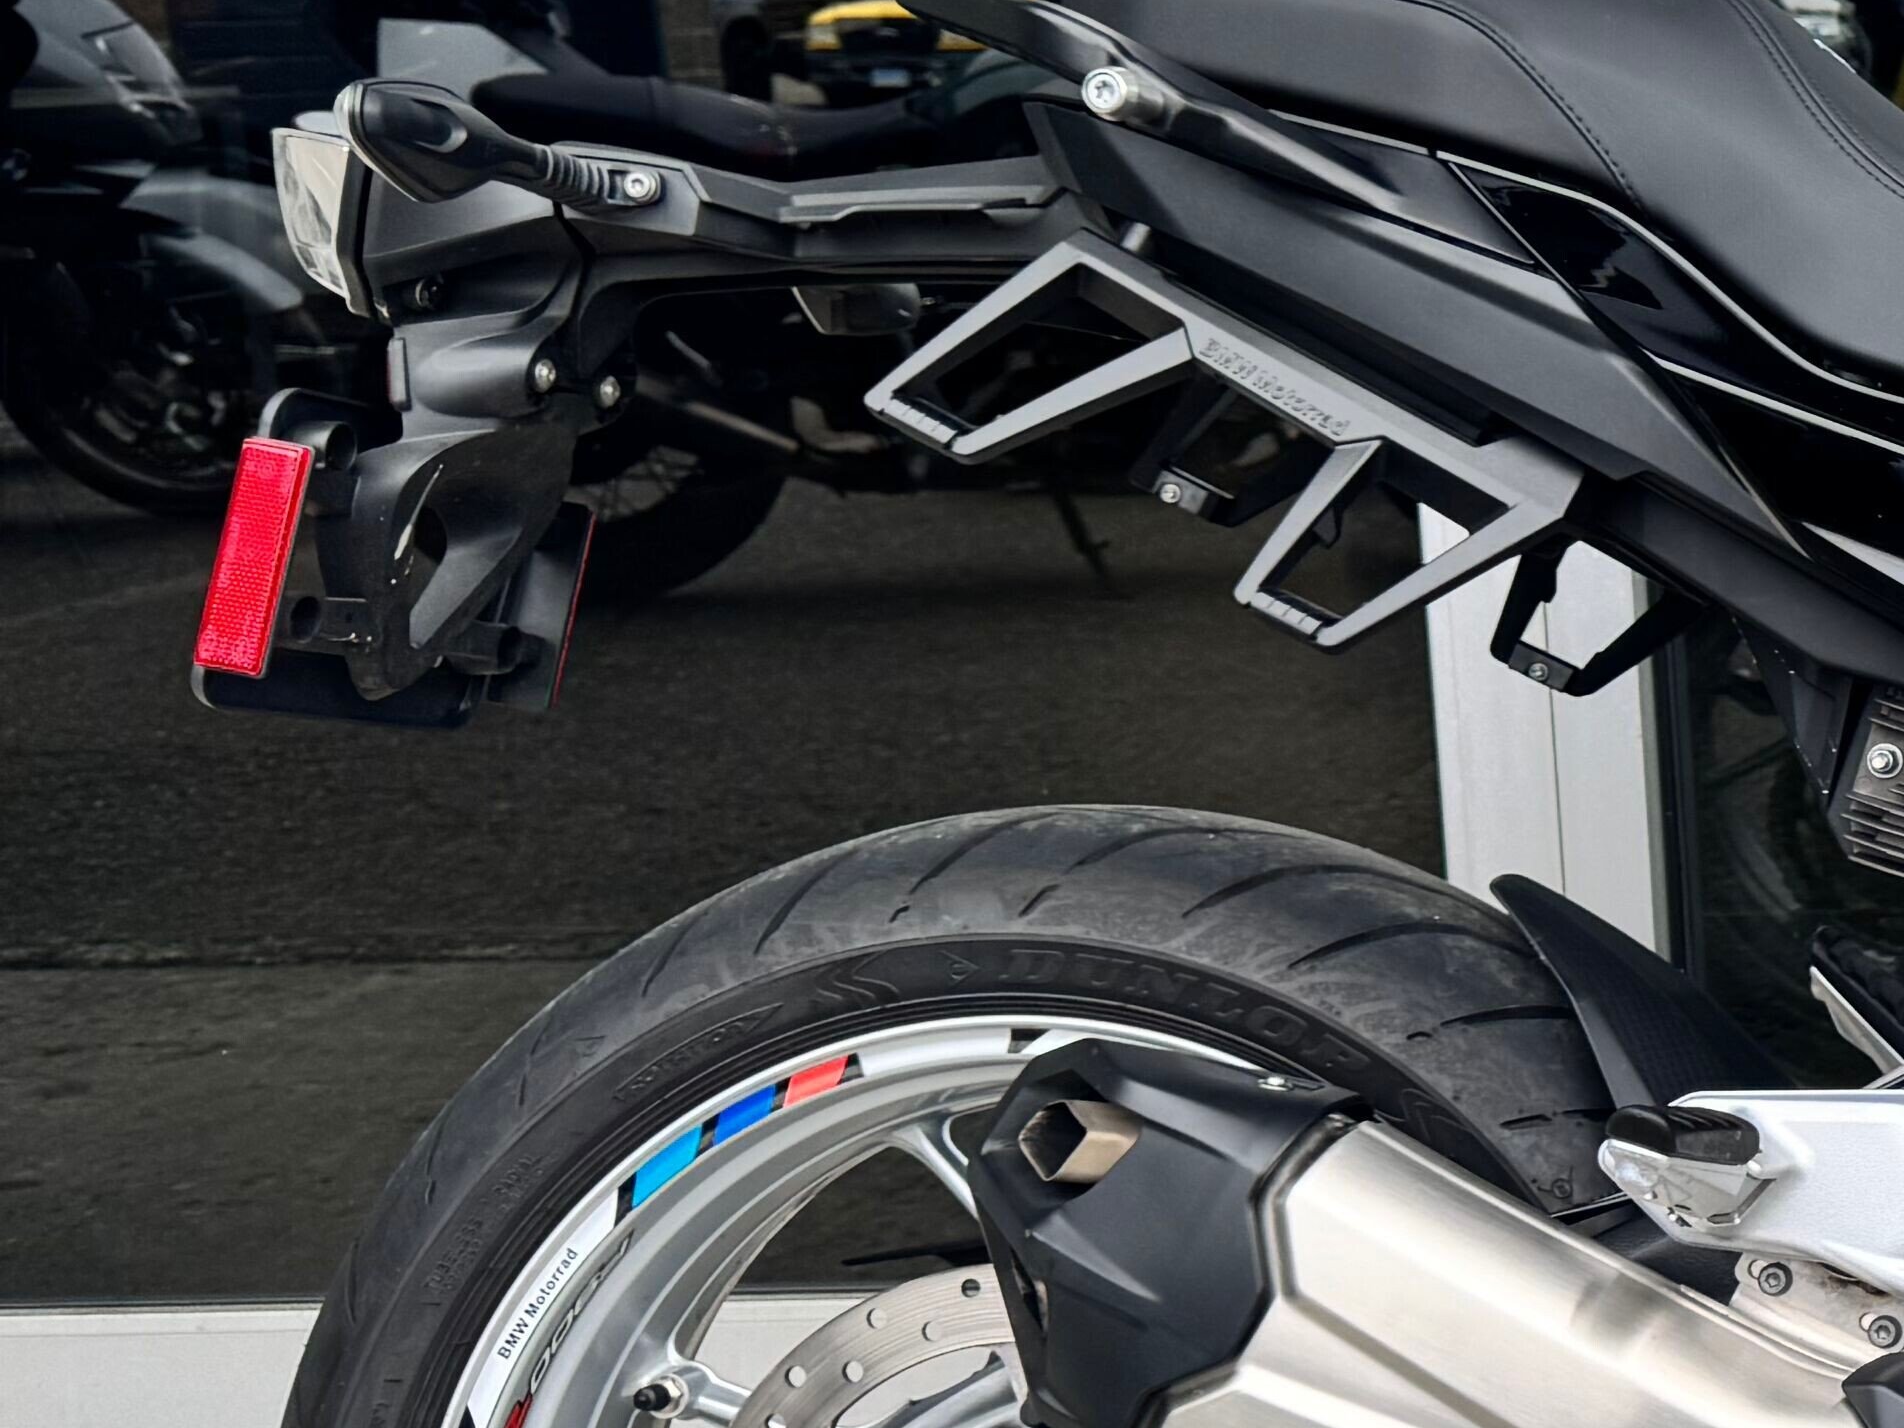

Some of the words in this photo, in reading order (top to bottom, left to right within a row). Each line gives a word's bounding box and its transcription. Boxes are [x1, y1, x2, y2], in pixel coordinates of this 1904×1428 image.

[1000, 947, 1372, 1070] DUNLOP
[497, 1317, 529, 1360] BMW
[524, 1247, 578, 1318] Motorrad
